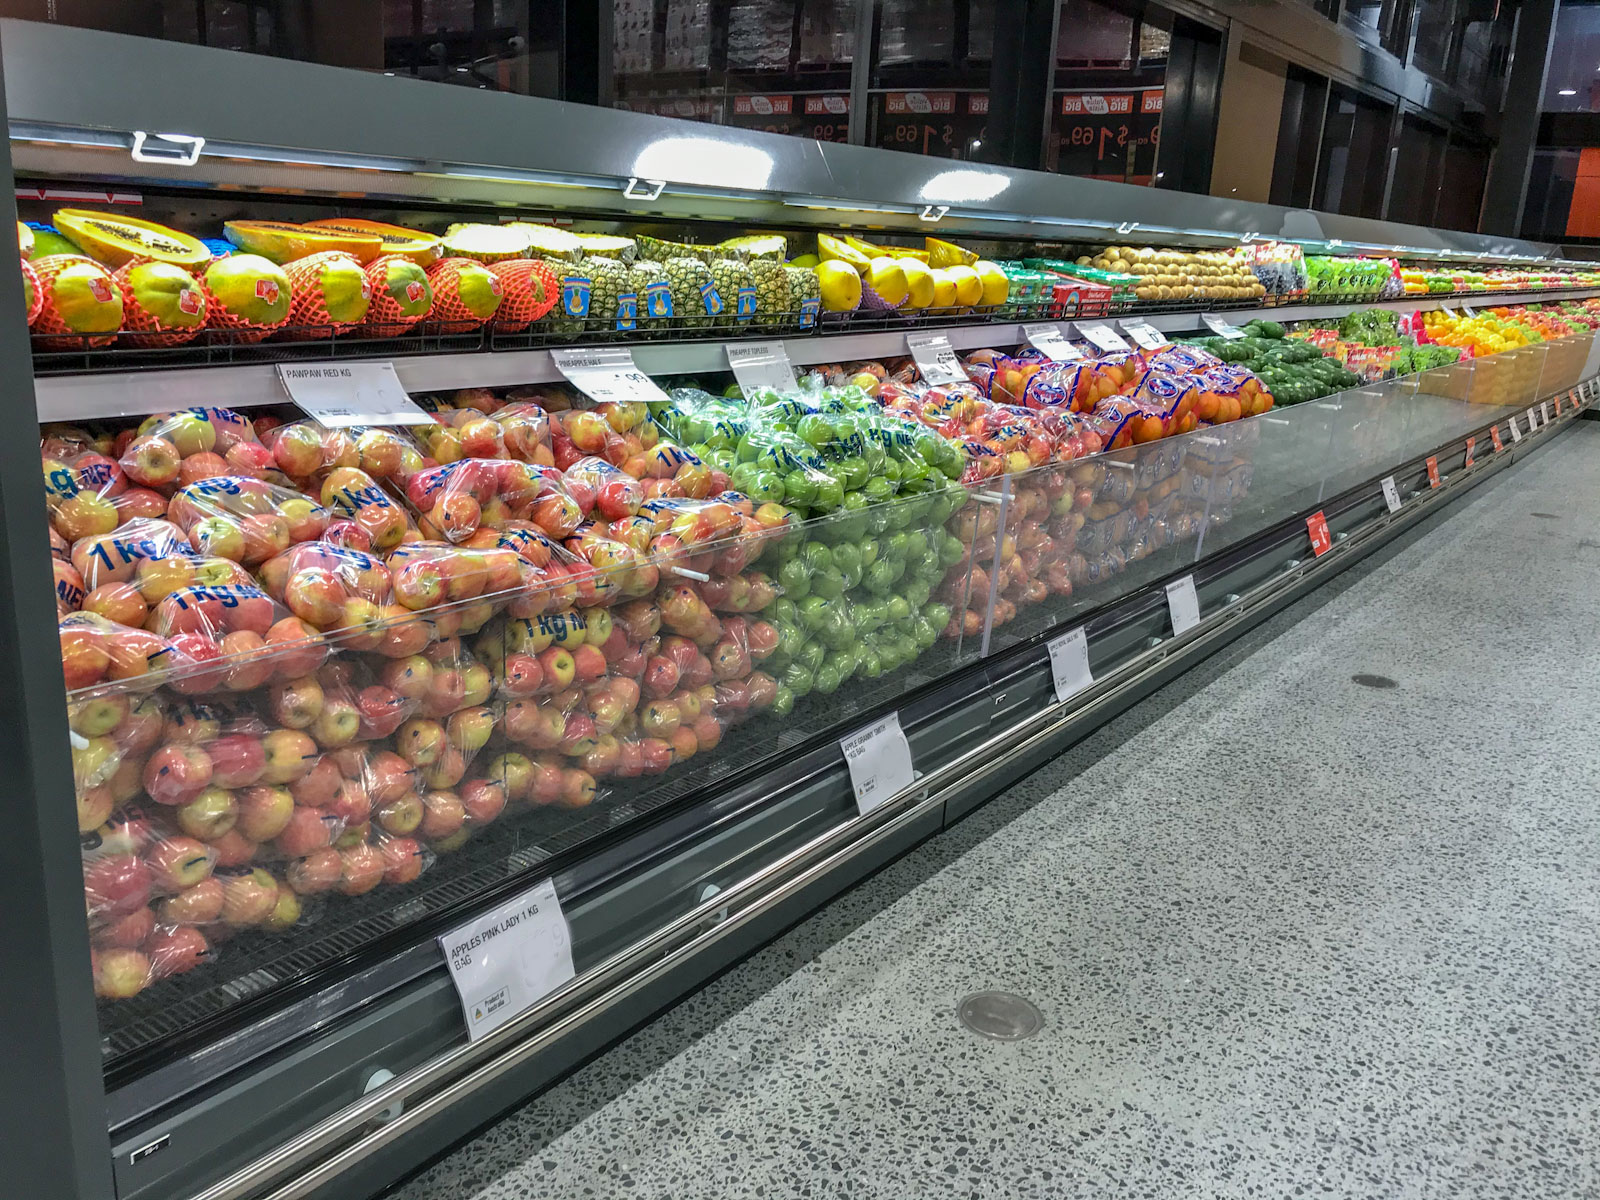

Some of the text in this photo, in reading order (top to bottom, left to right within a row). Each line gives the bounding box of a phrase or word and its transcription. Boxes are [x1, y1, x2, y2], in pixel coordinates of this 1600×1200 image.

[286, 368, 352, 378] PAWPAW RED KG
[558, 360, 588, 368] PINEAPPLE
[333, 486, 391, 517] 1kg
[89, 538, 174, 572] 1kg
[164, 584, 240, 611] 1kg
[516, 614, 568, 642] 1kg
[844, 742, 858, 752] APPLE
[451, 904, 540, 960] APPLES PINK LADY 1 KG
[454, 954, 473, 971] BAG
